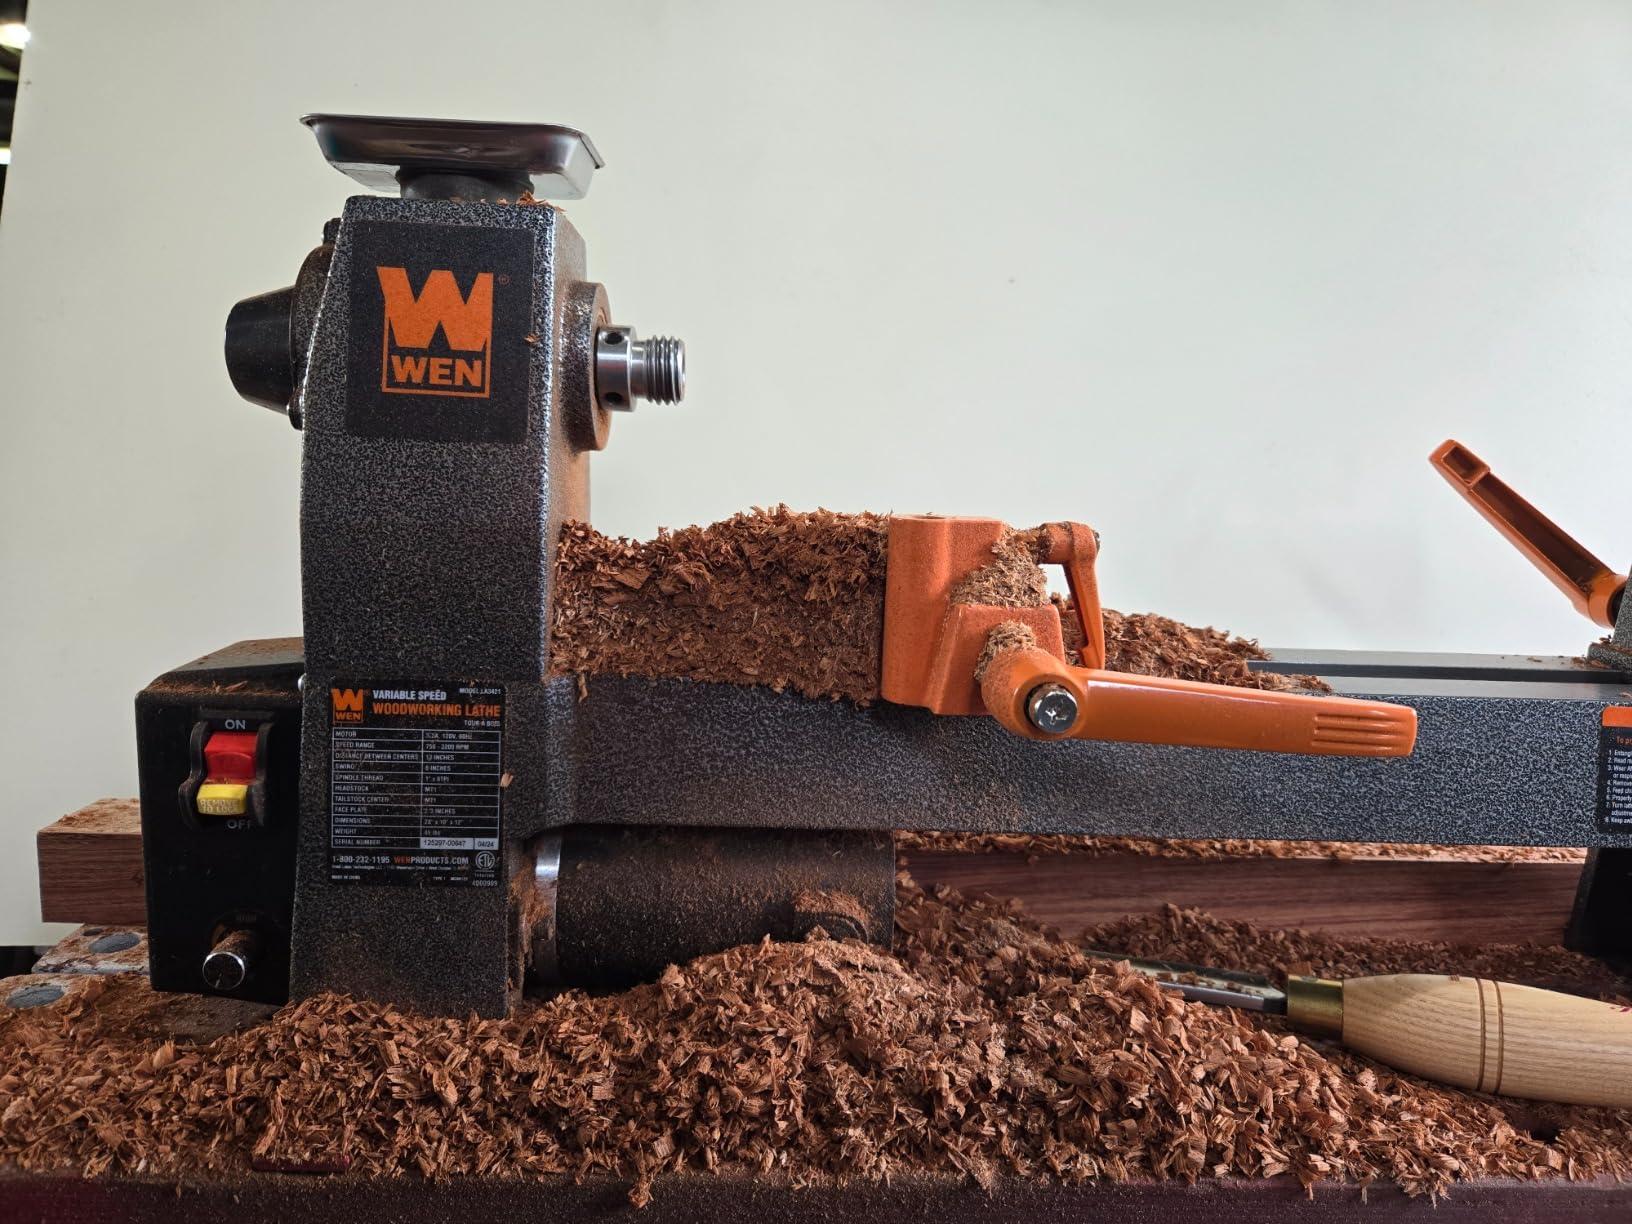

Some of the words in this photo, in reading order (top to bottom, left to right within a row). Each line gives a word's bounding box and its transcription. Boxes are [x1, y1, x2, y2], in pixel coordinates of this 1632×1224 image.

[391, 355, 482, 387] WEN
[373, 690, 416, 700] VARIABLE
[418, 690, 447, 700] SPEED
[373, 703, 462, 716] WOODWORKING
[465, 704, 501, 717] LATHE
[335, 712, 360, 720] WEN
[225, 719, 246, 730] ON
[1616, 736, 1624, 744] To
[200, 799, 236, 807] REMOVE
[332, 855, 390, 864] 1-800-232-1195
[393, 856, 469, 865] WENPRODUCTS.COM
